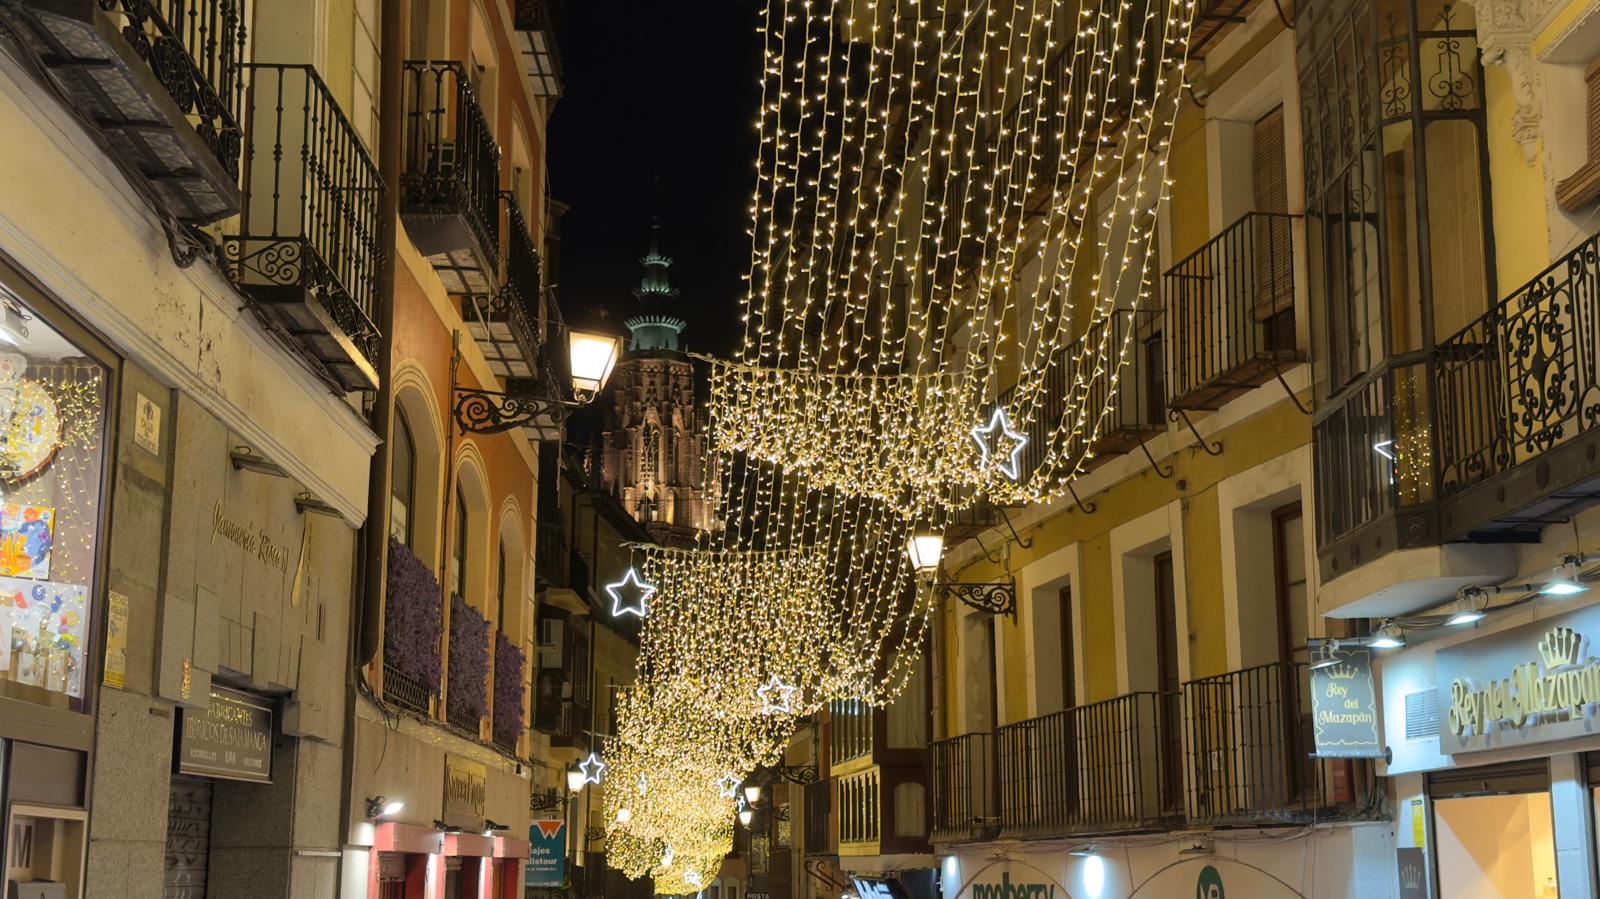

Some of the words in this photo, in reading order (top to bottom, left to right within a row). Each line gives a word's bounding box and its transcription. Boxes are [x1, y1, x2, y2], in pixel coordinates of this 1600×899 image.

[1325, 682, 1348, 698] Rey
[1343, 698, 1359, 709] del
[1449, 678, 1486, 736] Rey
[1483, 679, 1511, 721] del
[1318, 710, 1372, 725] Mazapán
